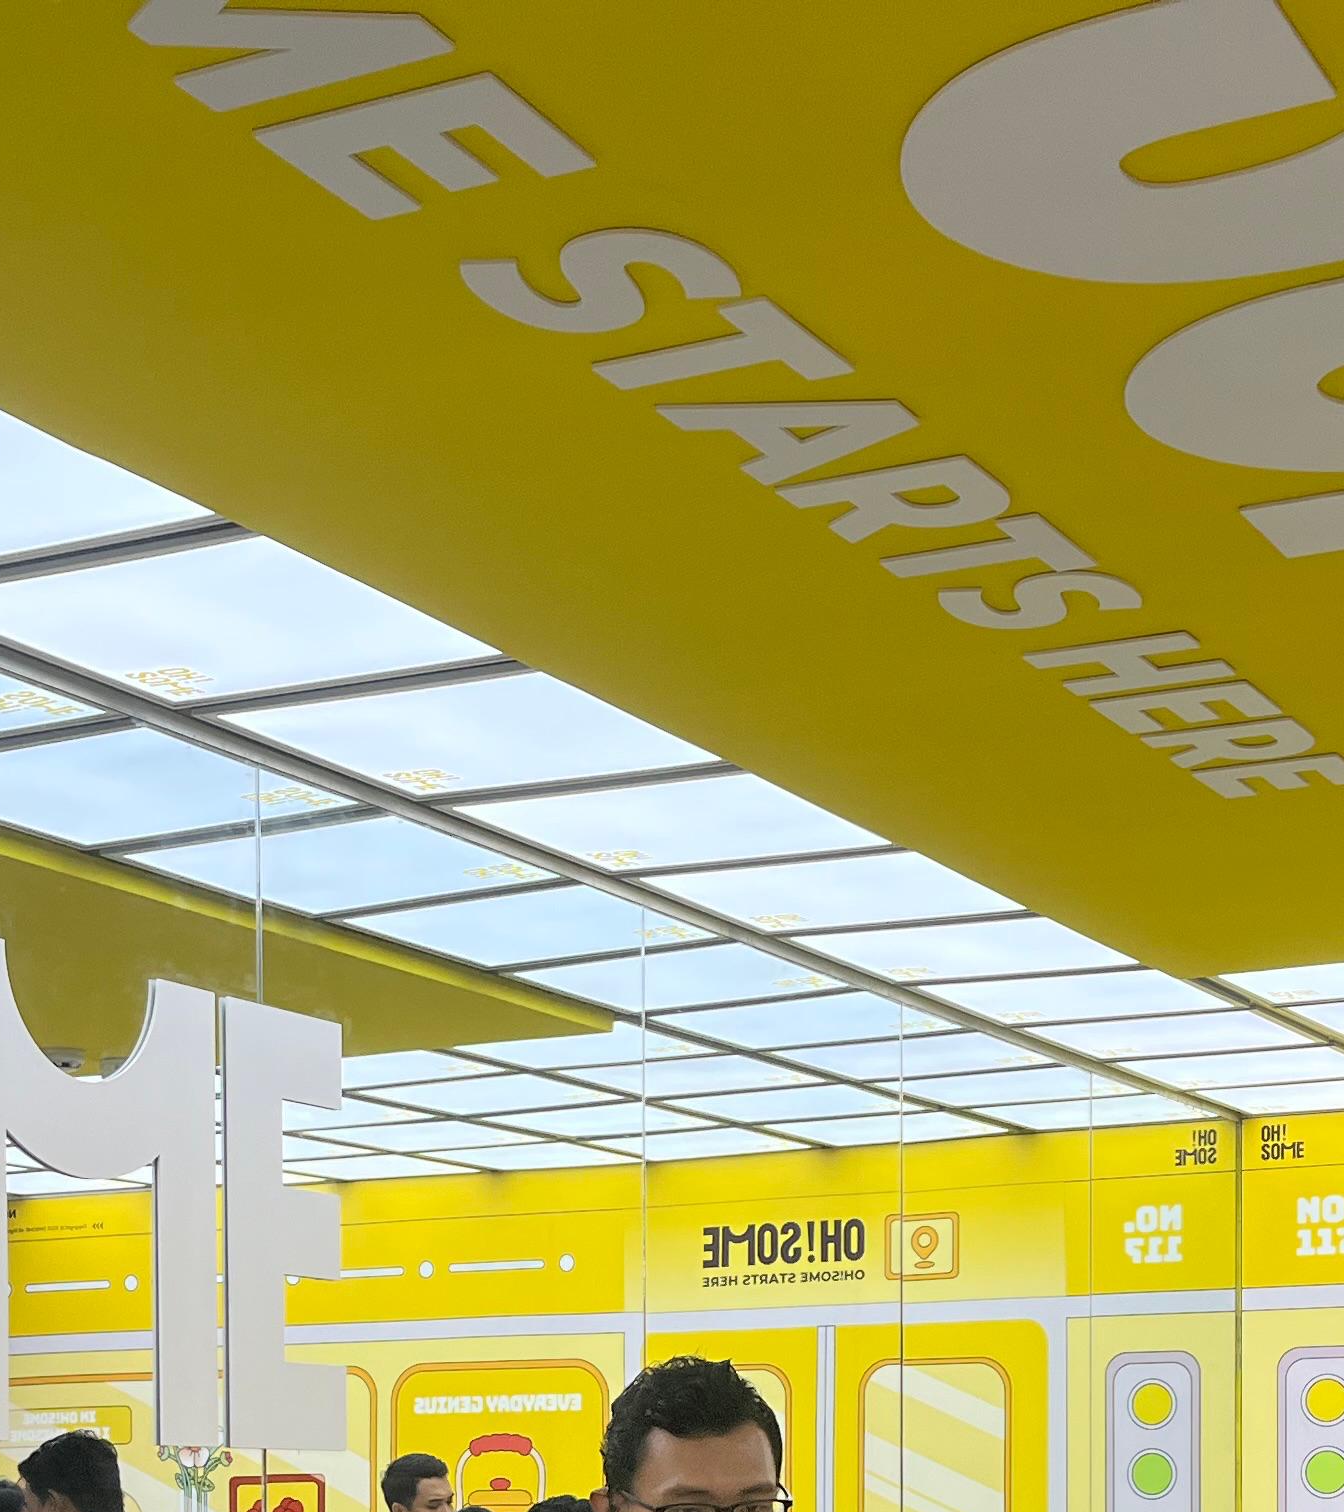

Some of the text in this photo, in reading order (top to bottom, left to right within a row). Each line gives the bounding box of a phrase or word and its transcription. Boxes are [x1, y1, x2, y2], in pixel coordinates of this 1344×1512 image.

[459, 226, 1142, 632] STARTS
[1261, 1124, 1287, 1142] OH!
[1261, 1142, 1304, 1160] SOME
